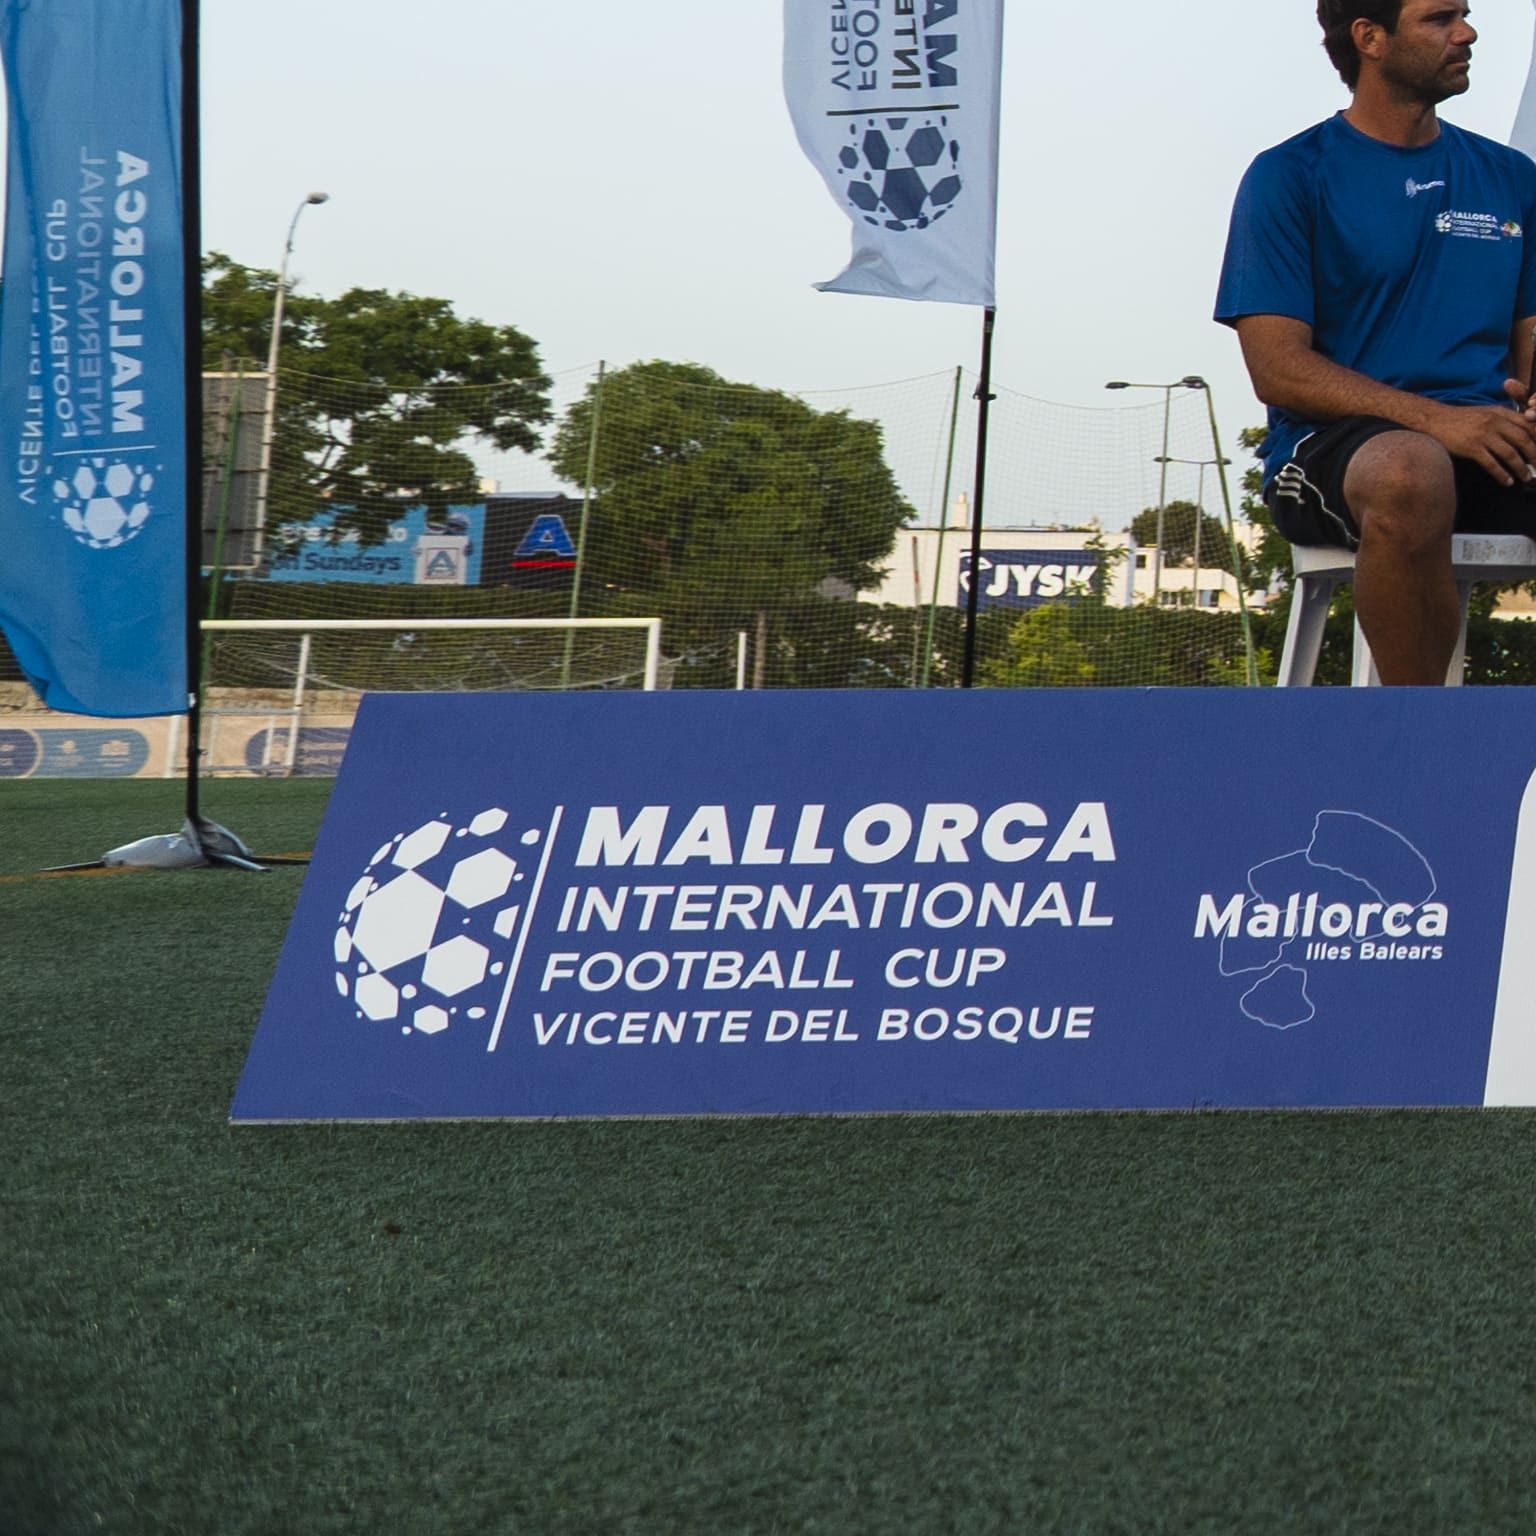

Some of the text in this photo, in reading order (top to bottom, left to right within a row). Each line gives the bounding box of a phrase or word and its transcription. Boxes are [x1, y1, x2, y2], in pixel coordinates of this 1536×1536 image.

[305, 552, 401, 575] Sundays
[985, 564, 1097, 597] JYSK
[575, 802, 1117, 867] MALLORCA
[556, 881, 1115, 932] INTERNATIONAL
[1193, 892, 1449, 939] Mallorca
[540, 948, 1008, 992] FOOTBALL CUP
[1306, 942, 1443, 961] Illes Balears
[532, 1006, 1096, 1046] VICENTE DEL BOSQUE
